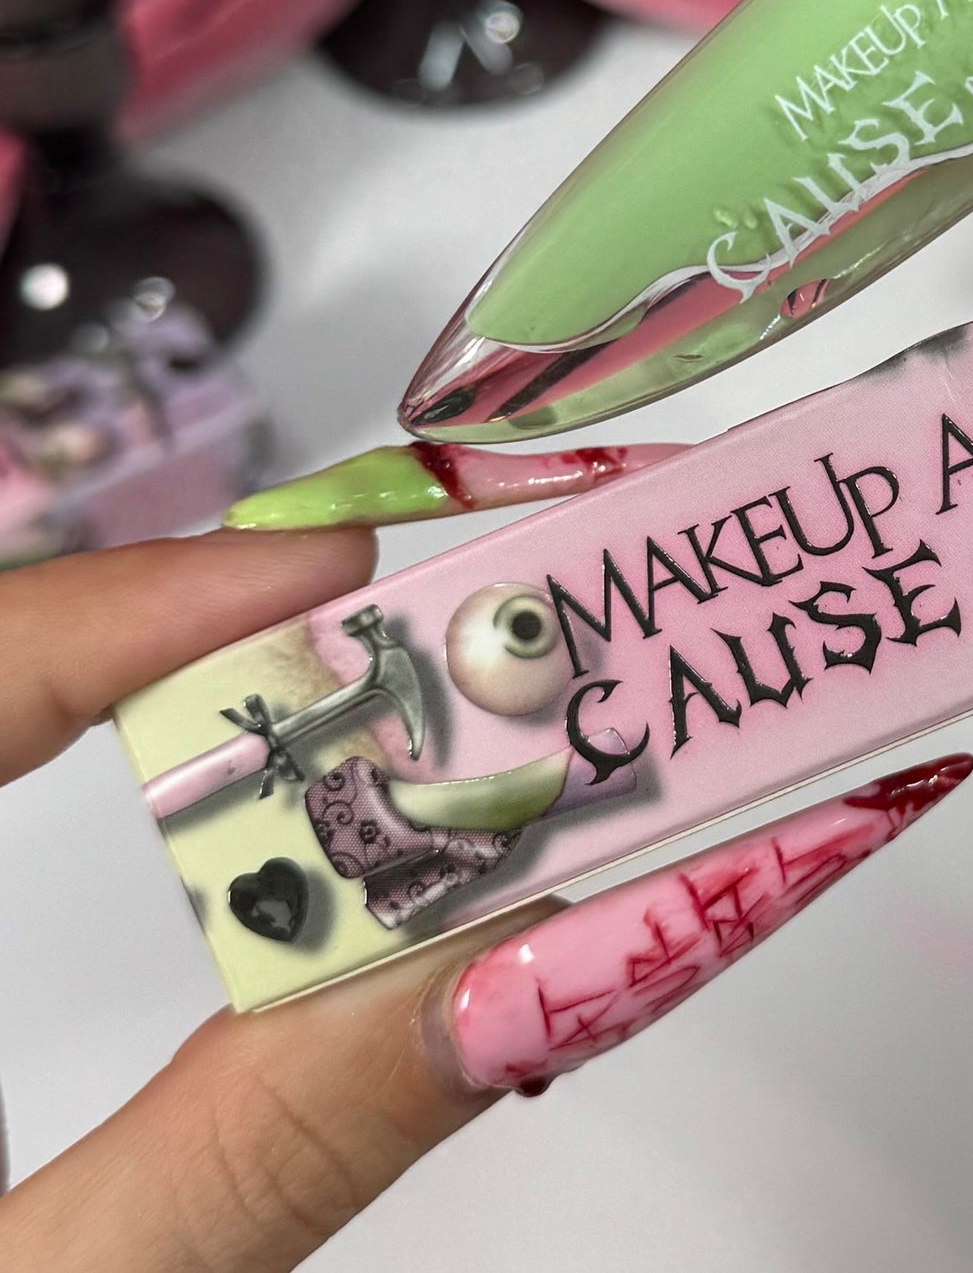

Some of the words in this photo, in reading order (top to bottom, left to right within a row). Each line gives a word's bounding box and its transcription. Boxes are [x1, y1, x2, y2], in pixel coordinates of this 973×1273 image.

[707, 71, 963, 303] CAUSE
[774, 5, 924, 141] MAKEUP
[546, 452, 900, 679] MAKEUP
[565, 539, 962, 785] CAUSE
